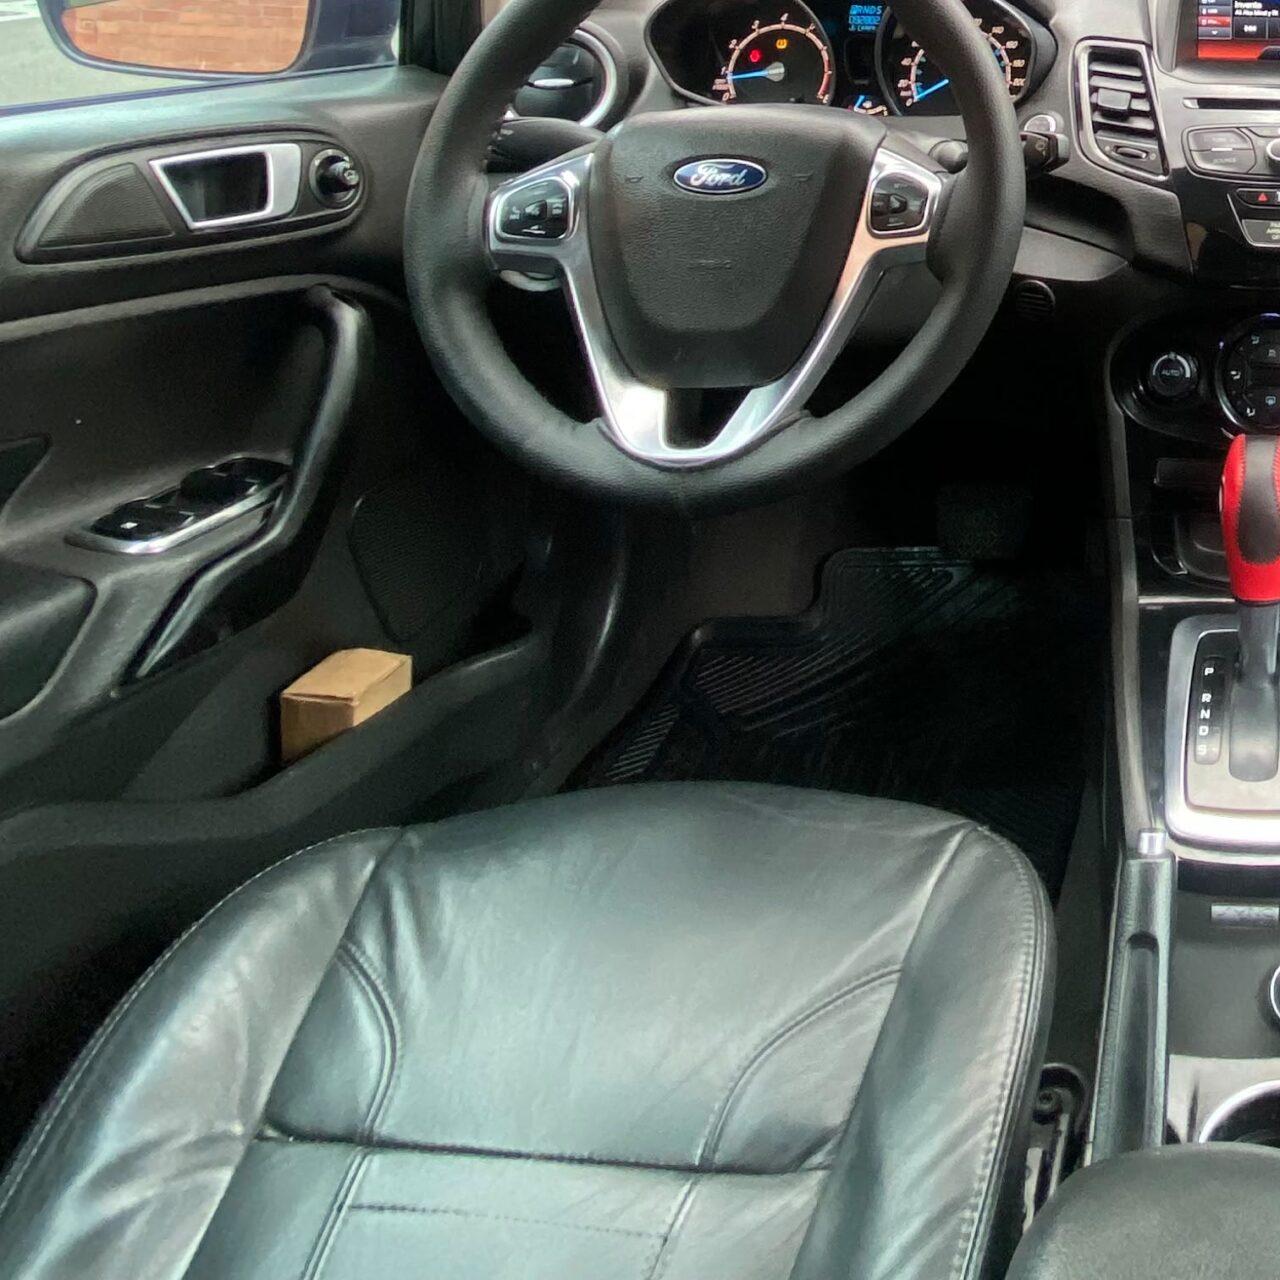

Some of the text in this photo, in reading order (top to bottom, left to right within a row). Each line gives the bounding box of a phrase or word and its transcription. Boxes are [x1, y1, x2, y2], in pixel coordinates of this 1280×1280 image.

[689, 162, 748, 187] Ford
[1161, 369, 1181, 377] AUTO
[1203, 666, 1215, 677] P
[1200, 692, 1213, 704] R
[1199, 708, 1212, 720] N
[1198, 724, 1210, 737] D
